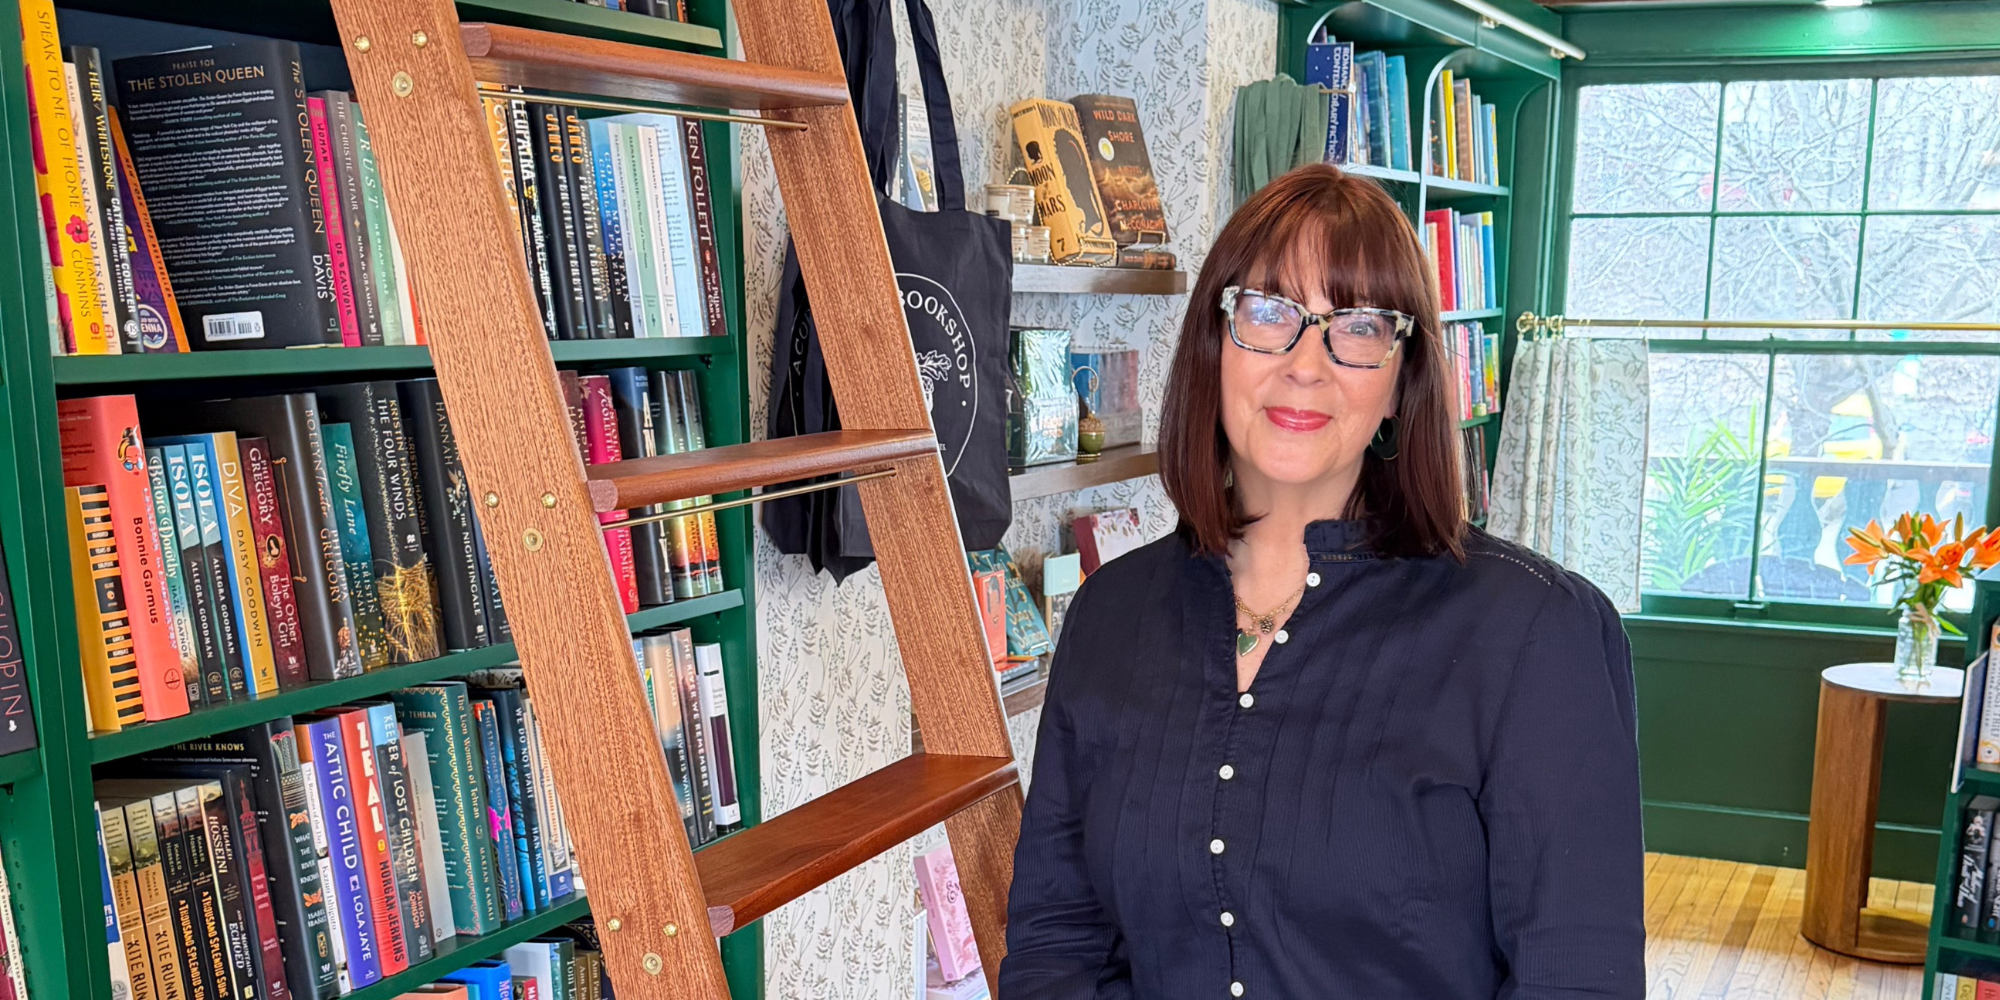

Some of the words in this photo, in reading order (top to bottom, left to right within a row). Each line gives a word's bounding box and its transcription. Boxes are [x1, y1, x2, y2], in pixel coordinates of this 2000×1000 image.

[37, 10, 57, 61] SPEAK
[47, 67, 61, 91] TO
[127, 78, 156, 92] THE
[159, 72, 212, 89] STOLEN
[215, 65, 265, 84] QUEEN
[172, 60, 197, 70] PRAISE
[200, 58, 215, 67] FOR
[291, 61, 301, 83] The
[1340, 46, 1351, 90] ROMANC
[52, 96, 67, 120] ME
[294, 88, 315, 164] STOLEN
[337, 101, 345, 120] THE
[1092, 110, 1115, 123] WILD
[1116, 110, 1137, 123] DARK
[58, 128, 71, 150] OF
[88, 71, 102, 102] HEIR
[96, 115, 116, 190] WHITESTONE
[317, 123, 329, 162] WOMAN
[340, 124, 352, 171] CHRISTIE
[545, 113, 564, 163] JAMES
[566, 115, 584, 164] JAMES
[685, 120, 700, 160] KEN
[1107, 130, 1135, 143] SHORE
[62, 157, 81, 208] HOME
[357, 120, 379, 208] TRUST
[1029, 163, 1056, 186] MOON
[304, 169, 325, 233] QUEEN
[347, 175, 359, 210] AFFAIR
[692, 165, 713, 247] FOLLETT
[1038, 194, 1066, 219] MARS
[1115, 199, 1160, 213] CHARLOTTE
[124, 157, 134, 179] NEW
[131, 183, 144, 208] YORK
[142, 212, 155, 239] TIMES
[151, 244, 172, 299] BESTSELLER
[374, 223, 385, 265] HERNAN
[599, 158, 612, 225] CHARLES
[609, 233, 622, 295] FRAZIER
[604, 151, 616, 200] COLD
[612, 209, 630, 302] MOUNTAIN
[111, 197, 127, 259] CATHERINE
[121, 262, 136, 313] COULTER
[312, 255, 328, 299] DAVIS
[71, 249, 92, 317] CUMMINS
[84, 257, 100, 309] JEANNINE
[323, 254, 336, 302] FIONA
[338, 262, 352, 316] BEAUVOIR
[362, 273, 374, 319] GRAMONT
[377, 398, 391, 425] THE
[436, 401, 454, 466] HANNAH
[600, 398, 614, 453] COLETTE
[305, 409, 322, 471] BOLEYN
[383, 430, 398, 469] FOUR
[390, 399, 404, 452] KRISTIN
[400, 457, 416, 518] HANNAH
[169, 456, 196, 538] ISOLA
[191, 454, 217, 535] ISOLA
[222, 461, 243, 518] DIVA
[249, 447, 273, 525] GREGORY
[260, 459, 274, 512] PHILIPPA
[334, 442, 353, 493] Firefly
[344, 498, 357, 535] Lane
[390, 472, 406, 521] WINDS
[149, 456, 168, 514] Before
[159, 517, 180, 580] Dorothy
[460, 512, 468, 528] THE
[690, 520, 698, 551] HASSAN
[132, 517, 147, 567] Bonnie
[142, 568, 159, 625] Garmus
[320, 528, 343, 603] GREGORY
[330, 529, 349, 601] PHILIPPA
[361, 561, 375, 613] KRISTIN
[462, 532, 481, 616] NIGHTINGALE
[171, 585, 182, 615] HAZEL
[190, 561, 204, 605] ALLEGRA
[199, 607, 214, 659] GOODMAN
[213, 558, 226, 602] ALLEGRA
[221, 604, 235, 655] GOODMAN
[236, 530, 250, 570] DAISY
[245, 576, 263, 648] GOODWIN
[269, 574, 283, 619] Boleyn
[278, 622, 291, 648] Girl
[280, 574, 290, 600] The
[285, 603, 297, 643] Other
[351, 562, 366, 616] HANNAH
[176, 618, 189, 659] GAYNOR
[684, 636, 692, 659] THE
[667, 648, 675, 681] WALLY
[686, 664, 697, 700] RIVER
[408, 711, 437, 719] TEHRAN
[457, 694, 465, 712] The
[515, 707, 523, 725] WE
[669, 683, 678, 707] LAMB
[691, 701, 700, 720] WE
[323, 731, 336, 740] THE
[383, 714, 400, 762] KEEPER
[460, 714, 468, 735] Lion
[518, 727, 525, 744] DO
[189, 743, 213, 751] RIVER
[215, 743, 245, 751] KNOWS
[463, 736, 473, 772] Women
[487, 730, 499, 786] STATIONERY
[521, 747, 529, 769] NOT
[694, 722, 709, 788] REMEMBER
[388, 765, 402, 776] of
[525, 772, 535, 800] PART
[677, 731, 686, 763] RIVER
[682, 776, 693, 817] WAITING
[324, 742, 346, 800] ATTIC
[336, 805, 358, 869] CHILD
[393, 779, 408, 813] LOST
[470, 786, 481, 819] Tehran
[165, 842, 175, 876] HOSSEINI
[208, 815, 228, 874] HOSSEINI
[221, 824, 233, 861] KHALED
[294, 833, 311, 844] WHAT
[400, 817, 419, 883] CHILDREN
[531, 826, 541, 850] HAN
[300, 859, 316, 870] RIVER
[320, 865, 331, 894] Kazuo
[379, 860, 397, 911] MORGAN
[479, 847, 489, 883] MARJAN
[484, 887, 495, 922] KAMALI
[535, 853, 545, 883] KANG
[179, 904, 195, 947] THOUSAND
[202, 895, 217, 938] THOUSAND
[325, 895, 337, 930] Ishiguro
[353, 895, 365, 930] LOLA
[359, 931, 372, 962] JAYE
[408, 890, 421, 929] JOHNSON
[127, 939, 144, 972] KITE
[155, 930, 172, 962] KITE
[229, 922, 245, 969] ECHOED
[387, 911, 405, 963] JERKINS
[567, 957, 576, 985] Tom
